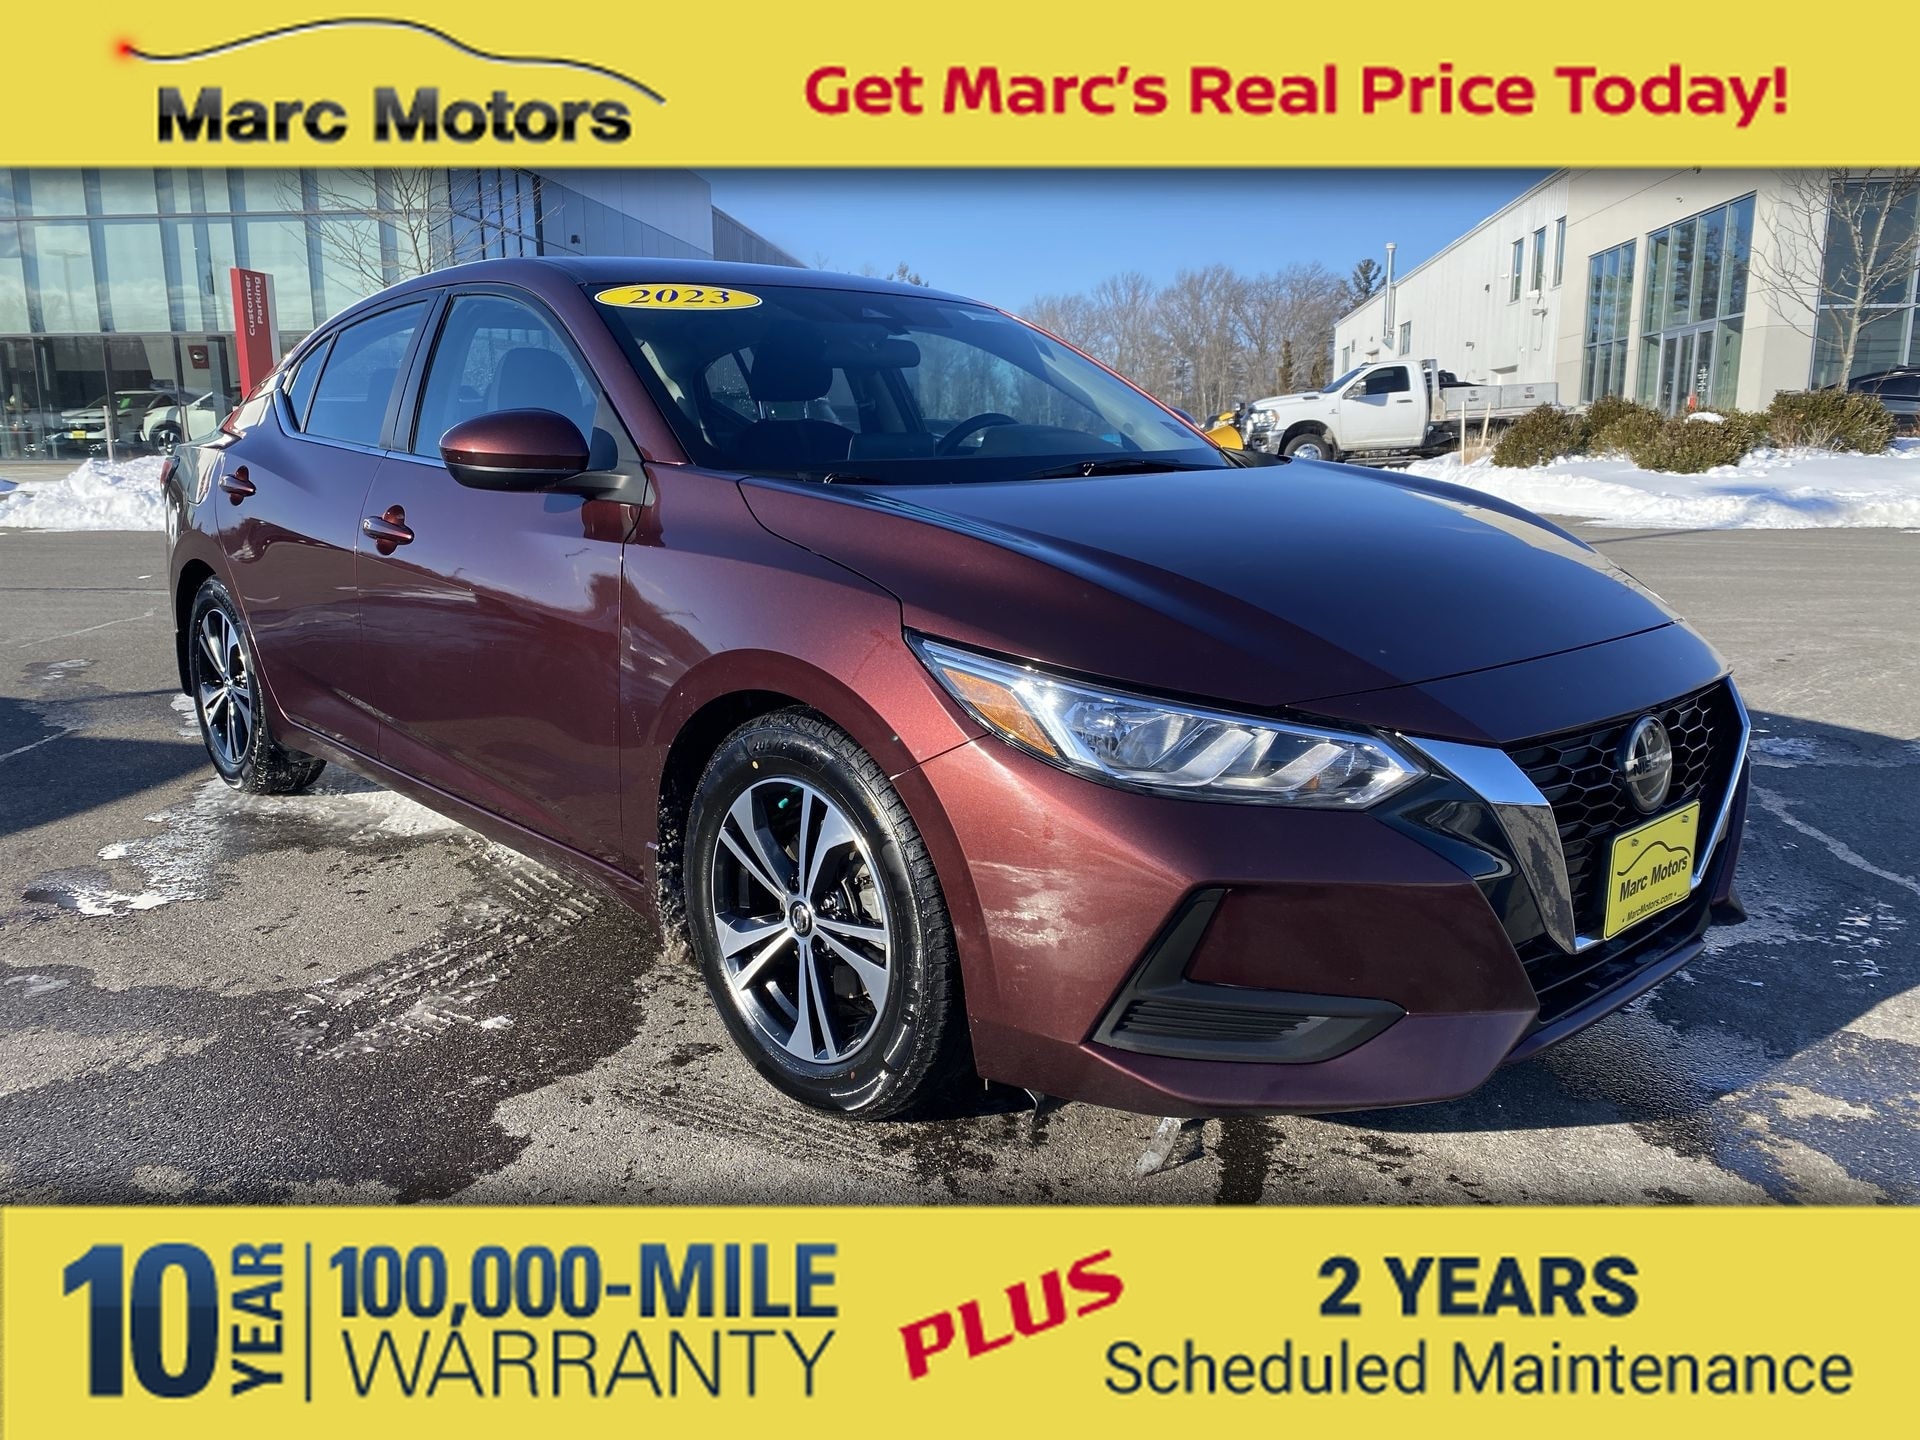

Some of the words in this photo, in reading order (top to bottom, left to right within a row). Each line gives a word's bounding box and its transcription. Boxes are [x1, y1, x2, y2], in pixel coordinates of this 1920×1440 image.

[245, 275, 255, 336] Customer
[254, 277, 264, 324] Parking
[629, 288, 730, 304] 2023
[1619, 875, 1648, 902] Marc
[1650, 856, 1688, 885] Motors
[1627, 892, 1673, 920] MarcMotors.com
